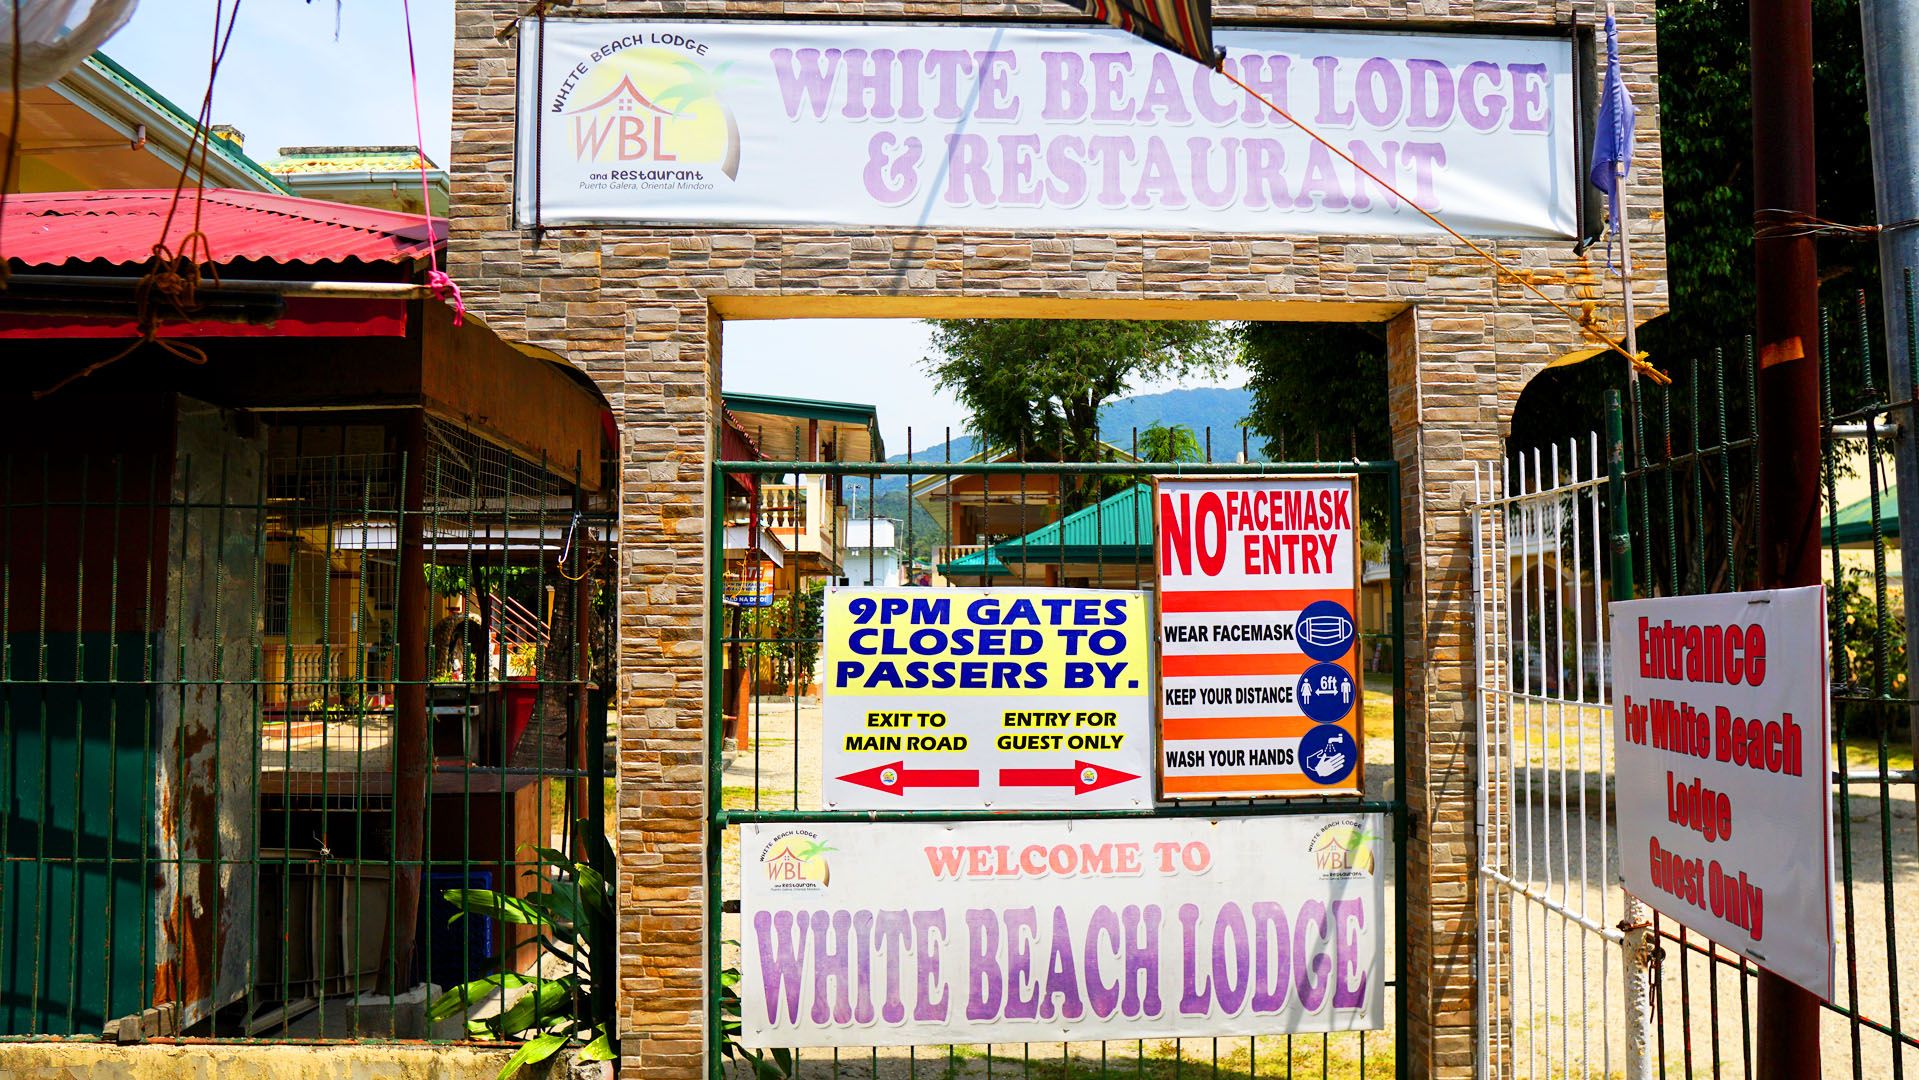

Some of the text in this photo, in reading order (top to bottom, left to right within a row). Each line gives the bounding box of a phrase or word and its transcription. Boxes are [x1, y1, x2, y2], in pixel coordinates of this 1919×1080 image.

[551, 33, 709, 113] WHITE BEACH LODGE
[769, 48, 1551, 132] WHITE BEACH LODGE
[575, 116, 677, 164] WBL
[579, 182, 714, 190] Puerto Galera, Oriental Mindoro
[589, 169, 704, 181] and Restaurant
[863, 131, 1447, 211] & RESTAURANT
[1226, 489, 1351, 532] FACEMASK
[1160, 491, 1227, 577] NO
[1244, 534, 1338, 575] ENTRY
[848, 597, 1127, 626] 9PM GATES
[848, 628, 1127, 656] CLOSED TO
[1164, 624, 1294, 642] WEAR FACEMASK
[1638, 616, 1766, 687] Entrance
[836, 661, 1139, 689] PASSERS BY.
[1320, 676, 1337, 690] 6ft
[1165, 686, 1293, 705] KEEP YOUR DISTANCE
[867, 713, 946, 728] EXIT TO
[1004, 712, 1117, 727] ENTRY FOR
[845, 736, 967, 751] MAIN ROAD
[997, 735, 1123, 750] GUEST ONLY
[1624, 695, 1803, 777] For White Beach
[1166, 748, 1294, 768] WASH YOUR HANDS
[1666, 771, 1732, 843] Lodge
[760, 829, 818, 862] WHITE BEACH LODGE
[1308, 832, 1321, 852] WHITE
[1320, 821, 1339, 832] BEACH
[768, 862, 807, 880] WBL
[923, 841, 1211, 877] WELCOME TO
[1316, 852, 1352, 870] WBL
[1649, 836, 1763, 942] Guest Only
[753, 897, 1368, 1026] WHITE BEACH LODGE
